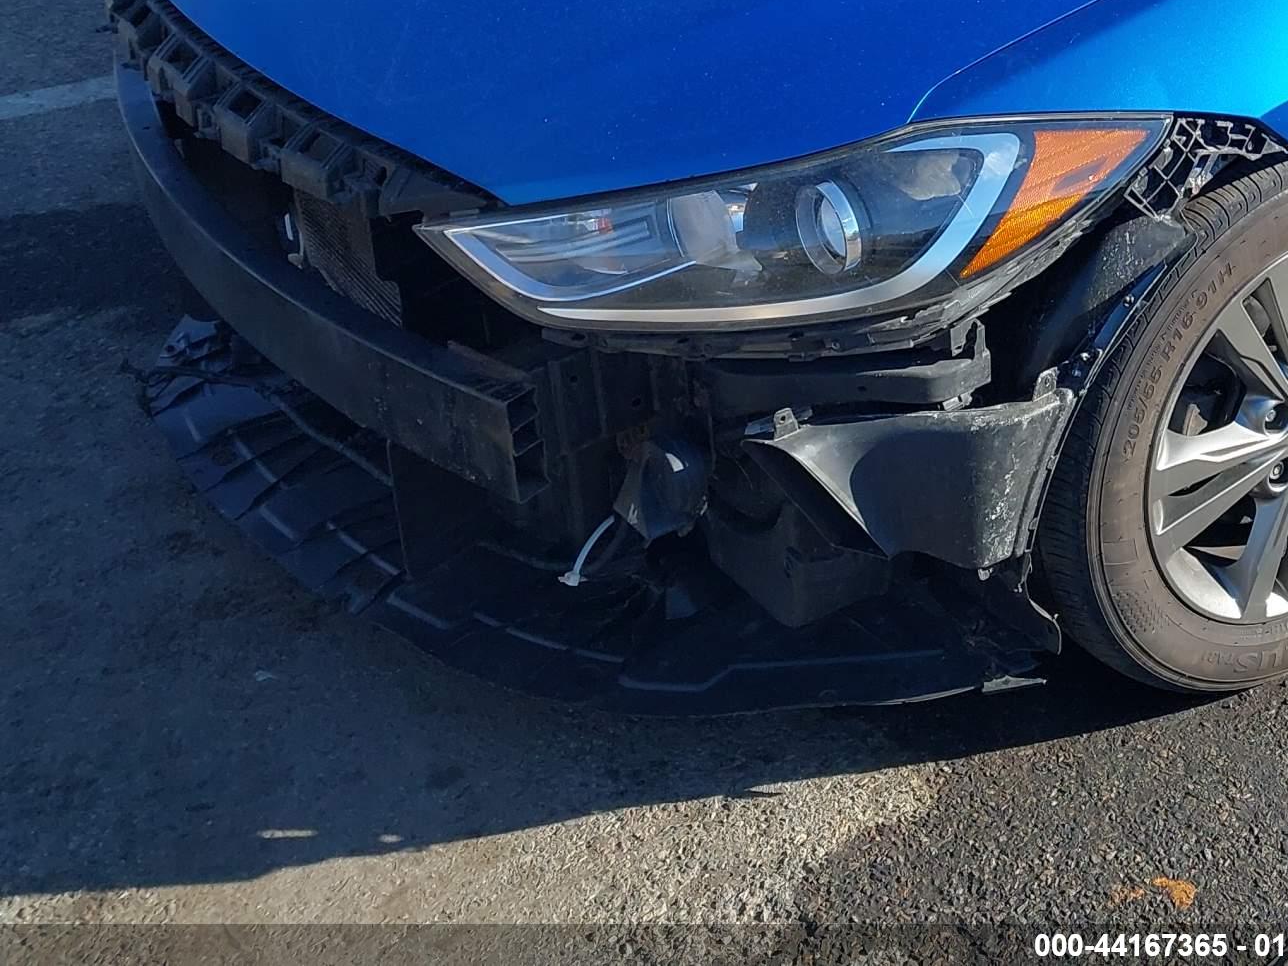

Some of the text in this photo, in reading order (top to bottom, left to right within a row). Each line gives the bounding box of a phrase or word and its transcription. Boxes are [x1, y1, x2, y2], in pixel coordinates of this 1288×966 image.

[1123, 365, 1162, 456] 205/55
[1160, 312, 1193, 361] R16
[1192, 262, 1237, 309] 91H
